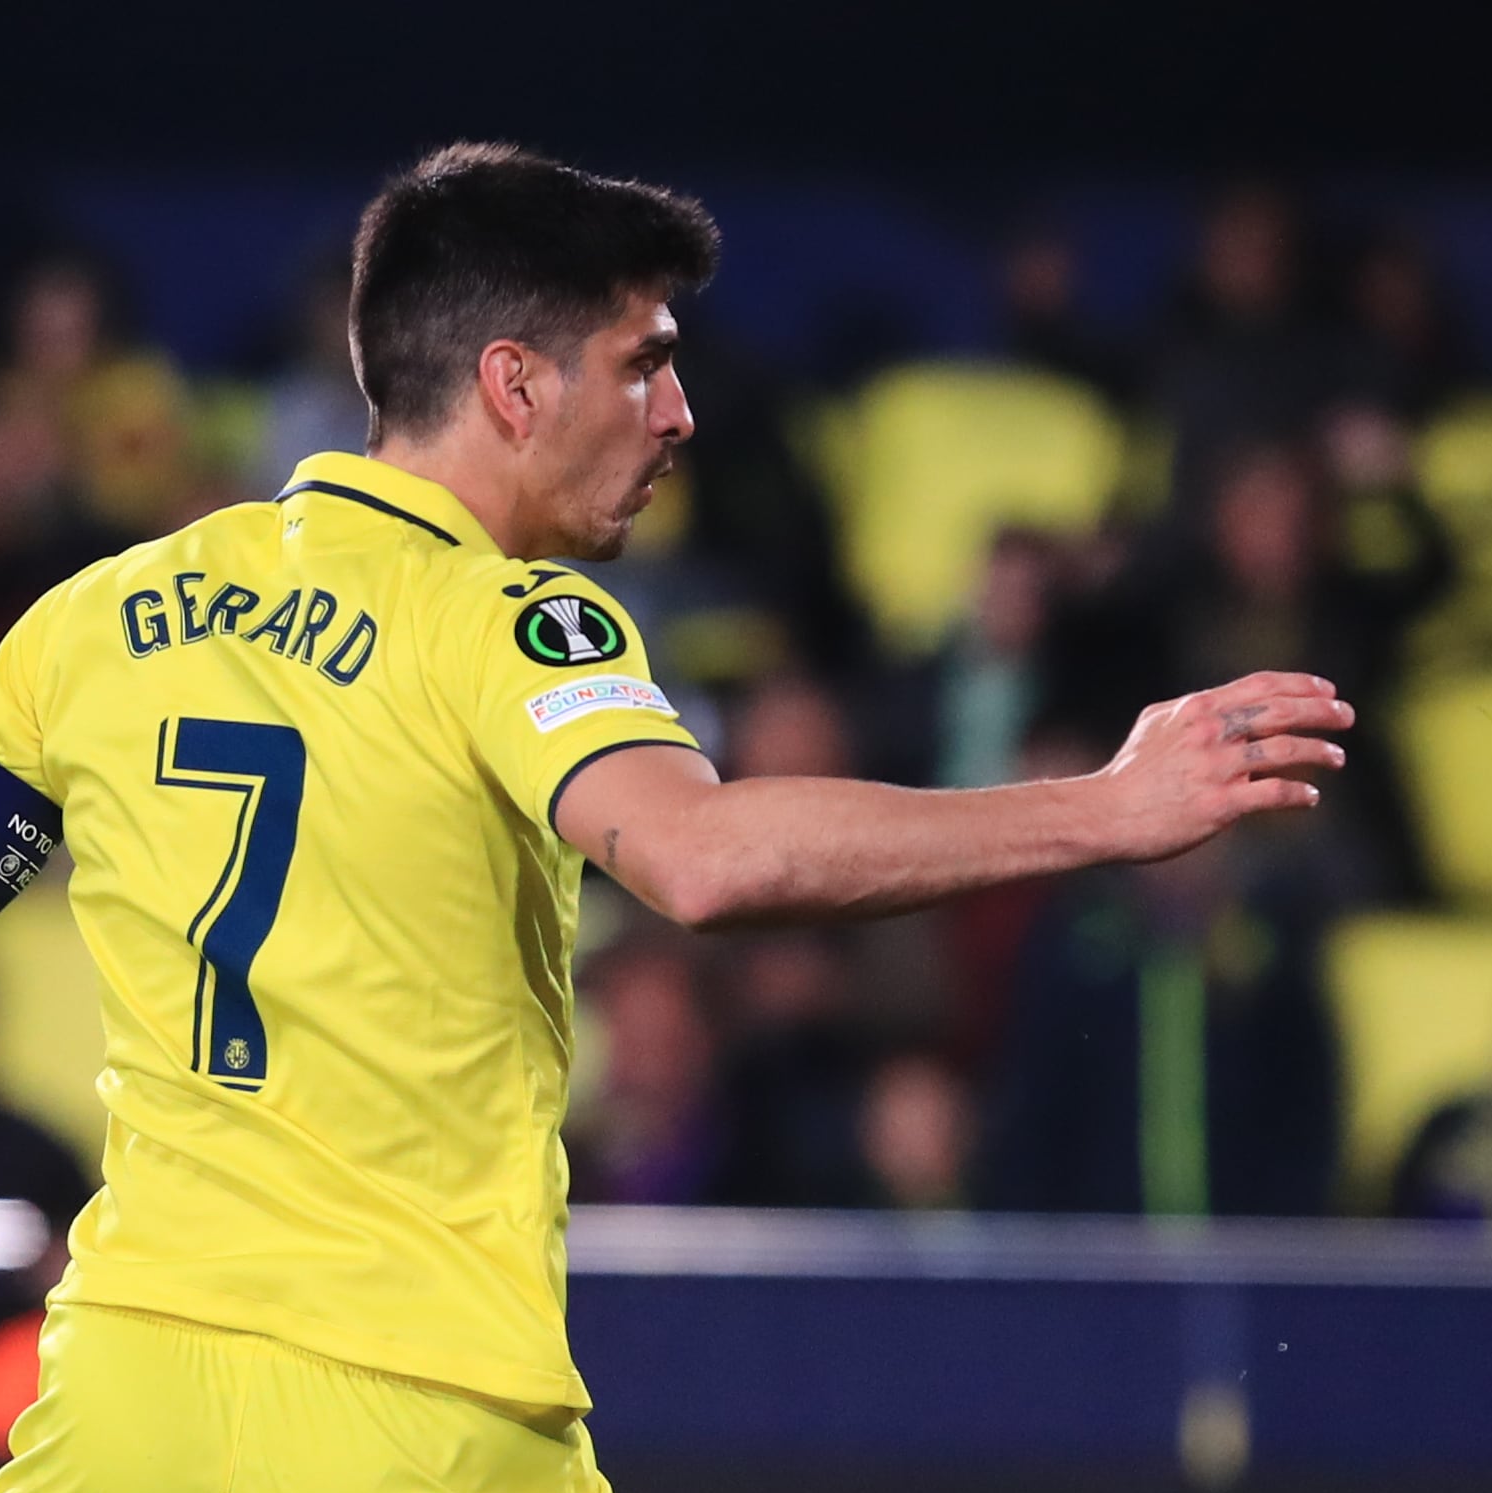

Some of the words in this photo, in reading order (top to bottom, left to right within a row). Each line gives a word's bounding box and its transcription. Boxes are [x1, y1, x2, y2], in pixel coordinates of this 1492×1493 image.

[121, 572, 379, 686] GERARD
[534, 684, 666, 721] FOUNDATION
[7, 813, 37, 842] NO
[35, 832, 53, 855] TO
[155, 715, 307, 1093] 7
